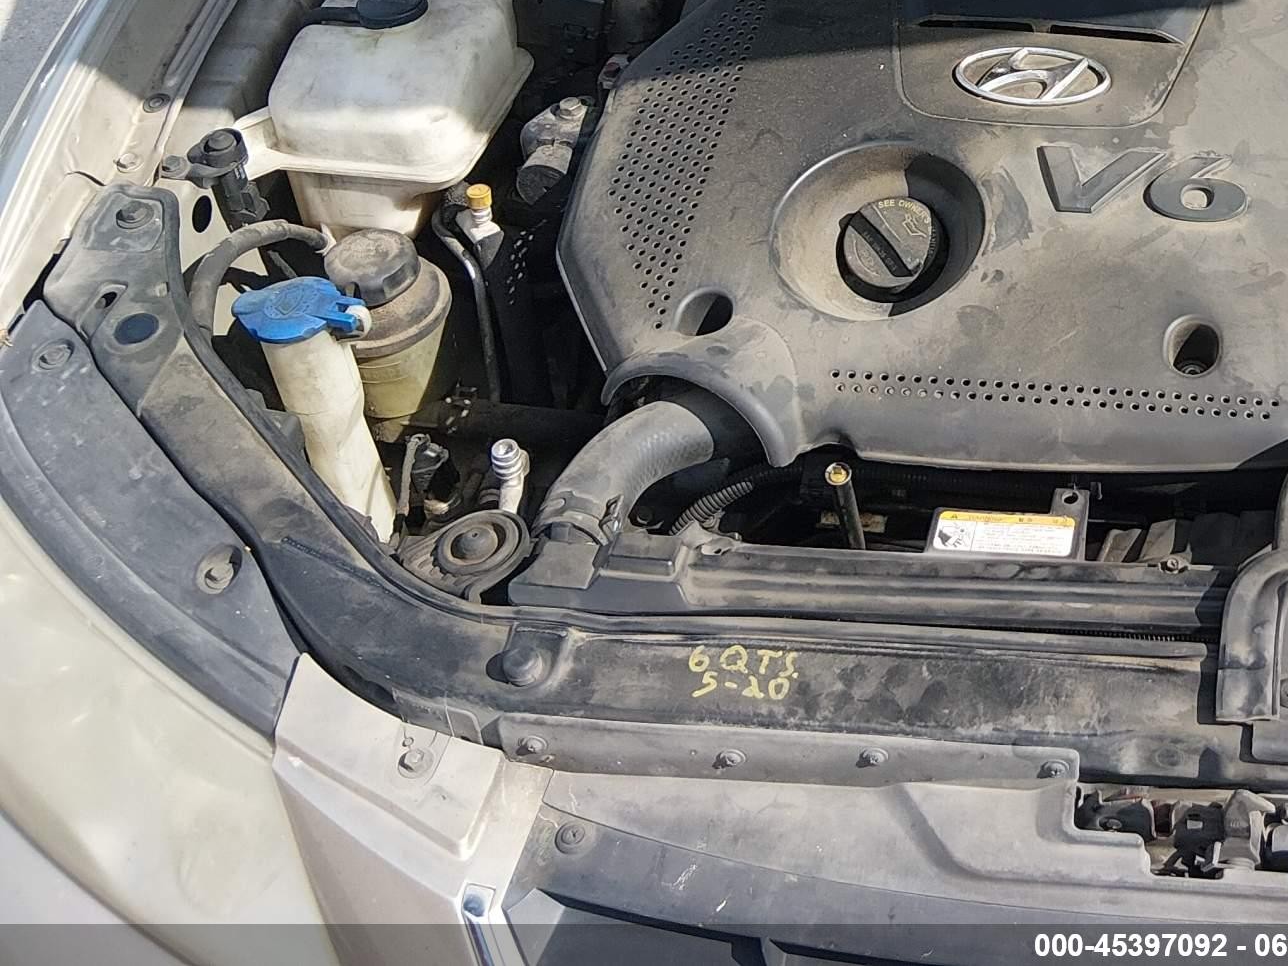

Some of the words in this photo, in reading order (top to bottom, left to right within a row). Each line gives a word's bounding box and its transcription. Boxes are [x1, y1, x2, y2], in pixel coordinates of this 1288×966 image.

[1035, 141, 1249, 223] V6
[878, 199, 896, 208] SEE
[691, 671, 790, 701] 5-20
